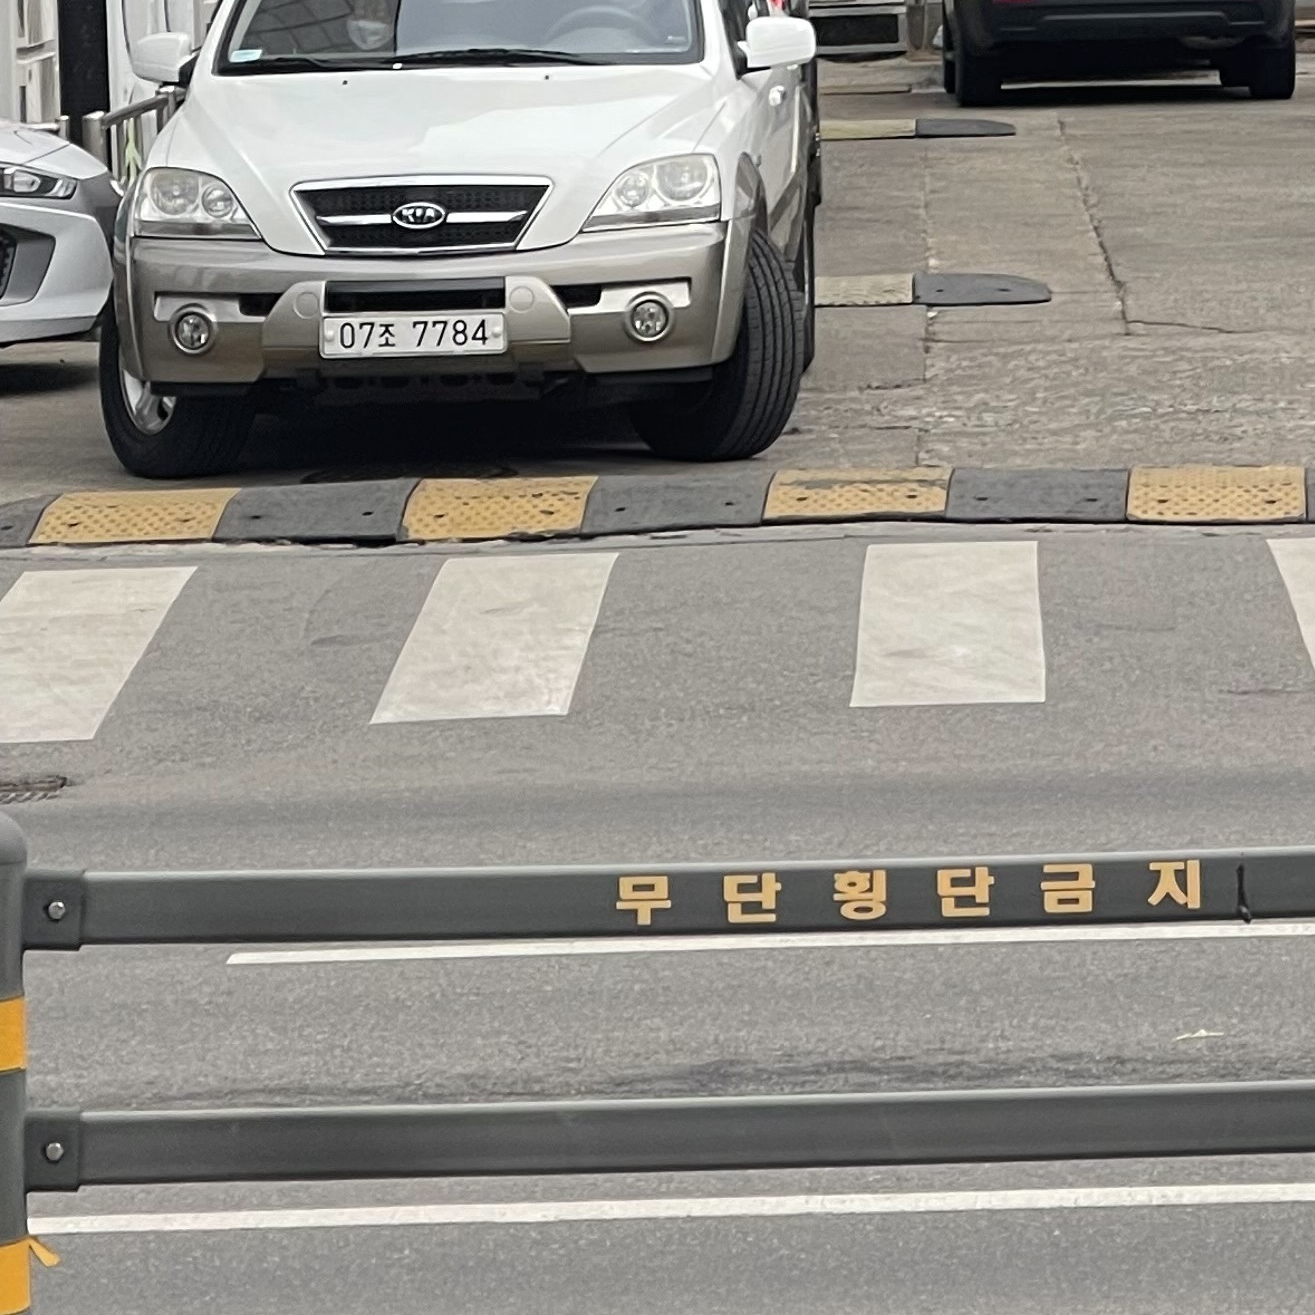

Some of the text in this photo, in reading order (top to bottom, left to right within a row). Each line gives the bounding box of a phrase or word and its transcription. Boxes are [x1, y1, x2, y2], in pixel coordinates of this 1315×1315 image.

[401, 207, 436, 223] KIA
[339, 318, 489, 349] 07조 7784
[616, 858, 1201, 926] 무단횡단금지
